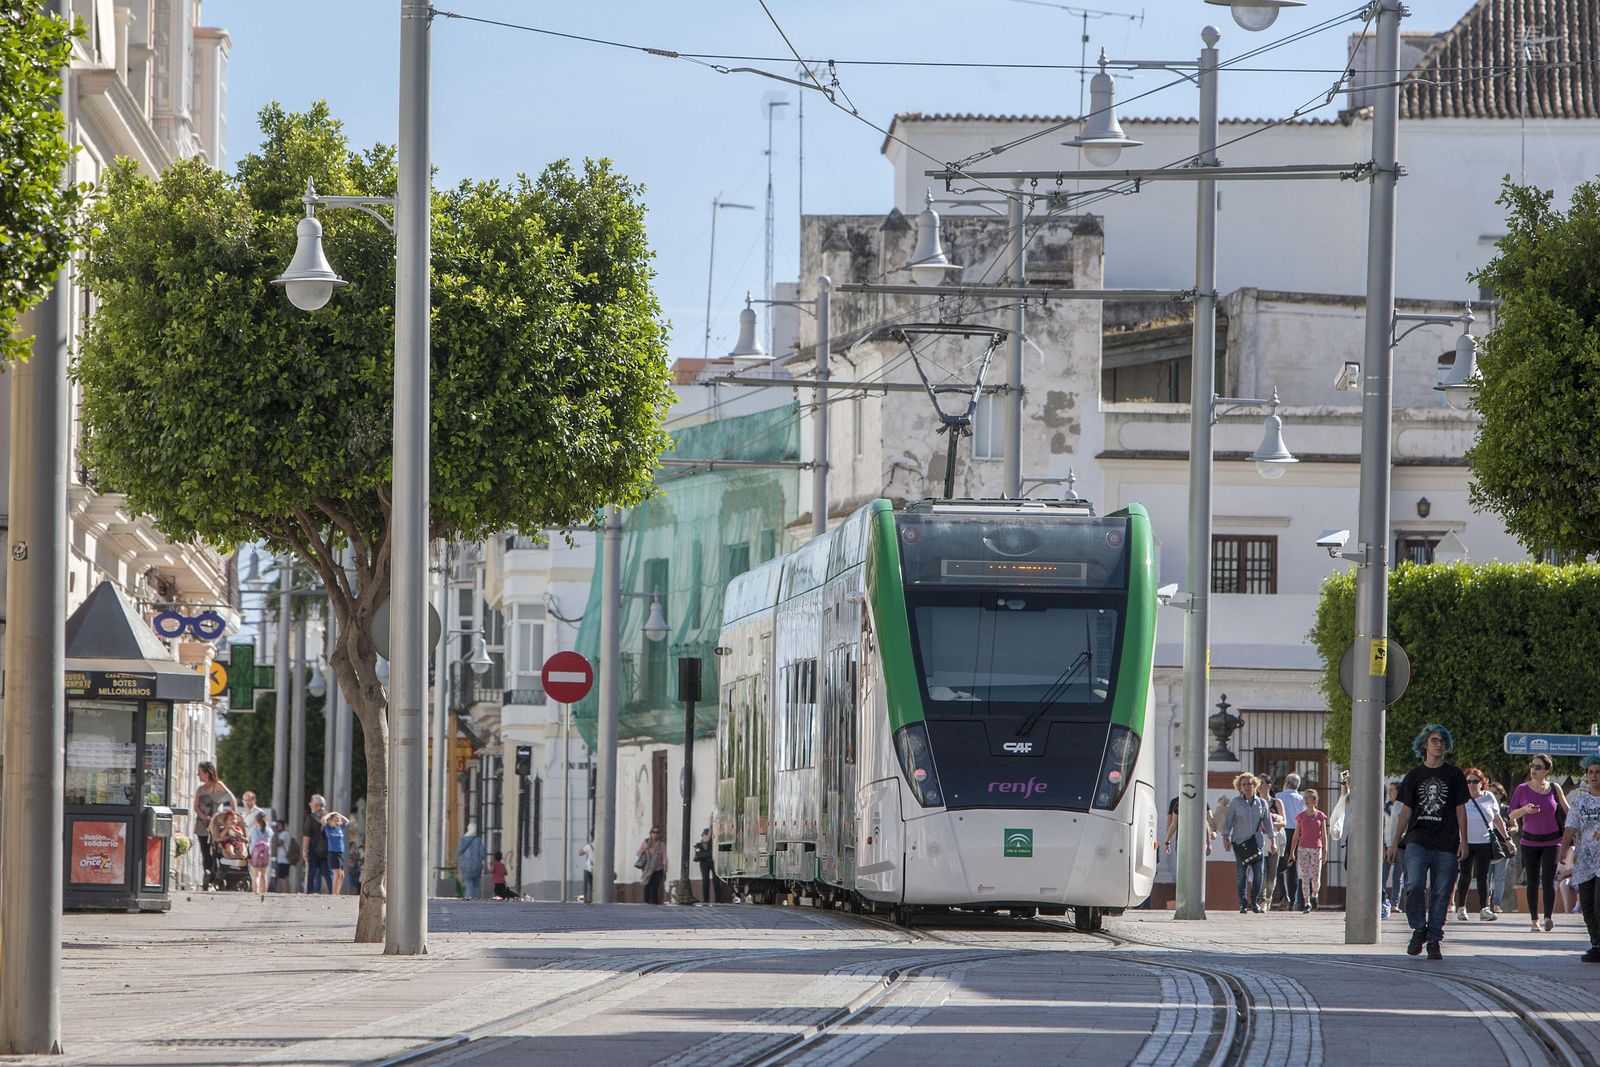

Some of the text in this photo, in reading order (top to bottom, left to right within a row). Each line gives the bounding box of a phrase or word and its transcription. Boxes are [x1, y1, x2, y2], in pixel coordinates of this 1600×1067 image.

[113, 679, 137, 687] BOTES
[98, 687, 151, 696] MILLONARIOS
[1003, 742, 1033, 753] CAF
[988, 776, 1048, 799] renfe
